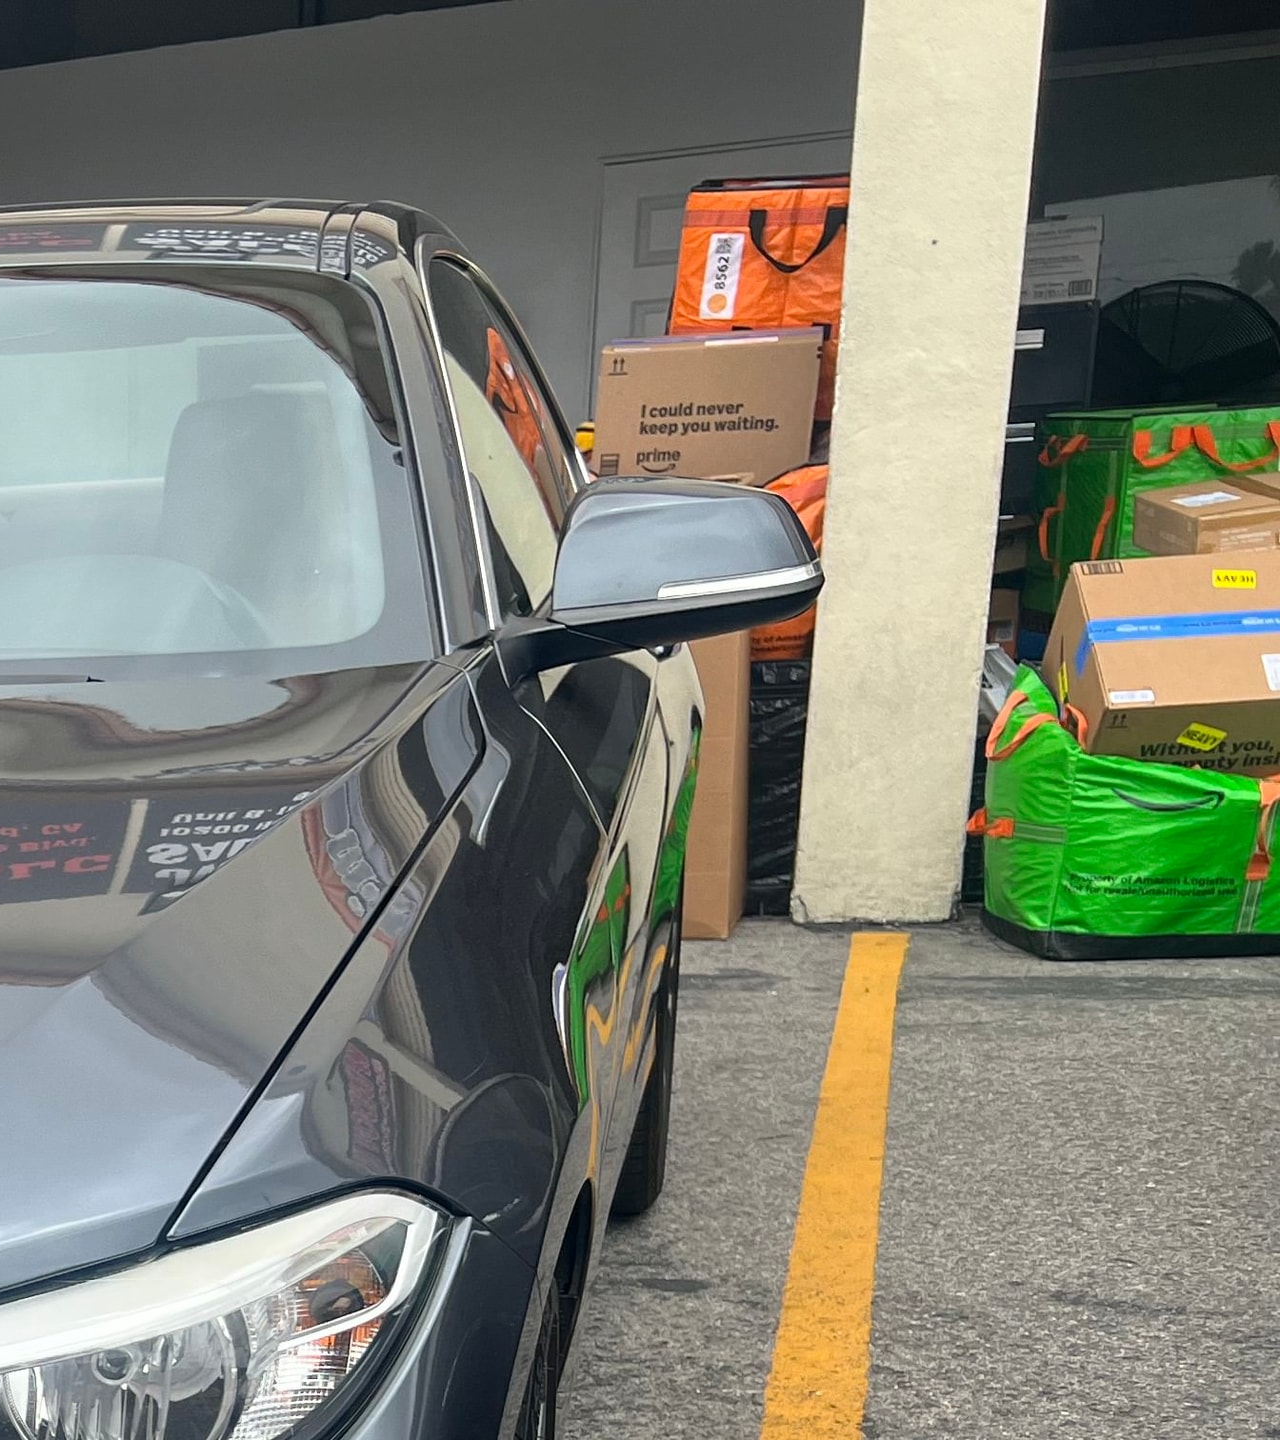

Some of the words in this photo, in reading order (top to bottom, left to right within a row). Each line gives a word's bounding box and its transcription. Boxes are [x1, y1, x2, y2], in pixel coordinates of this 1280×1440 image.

[714, 255, 731, 290] 8562
[640, 404, 646, 417] I
[649, 402, 693, 417] could
[696, 403, 744, 416] never
[639, 421, 677, 436] keep
[680, 421, 711, 436] you
[714, 416, 779, 435] waiting.
[636, 447, 681, 466] prime
[1182, 729, 1221, 745] HEAVY
[1228, 740, 1274, 754] you,
[1134, 876, 1180, 885] Amazon
[1183, 876, 1235, 887] Logistics
